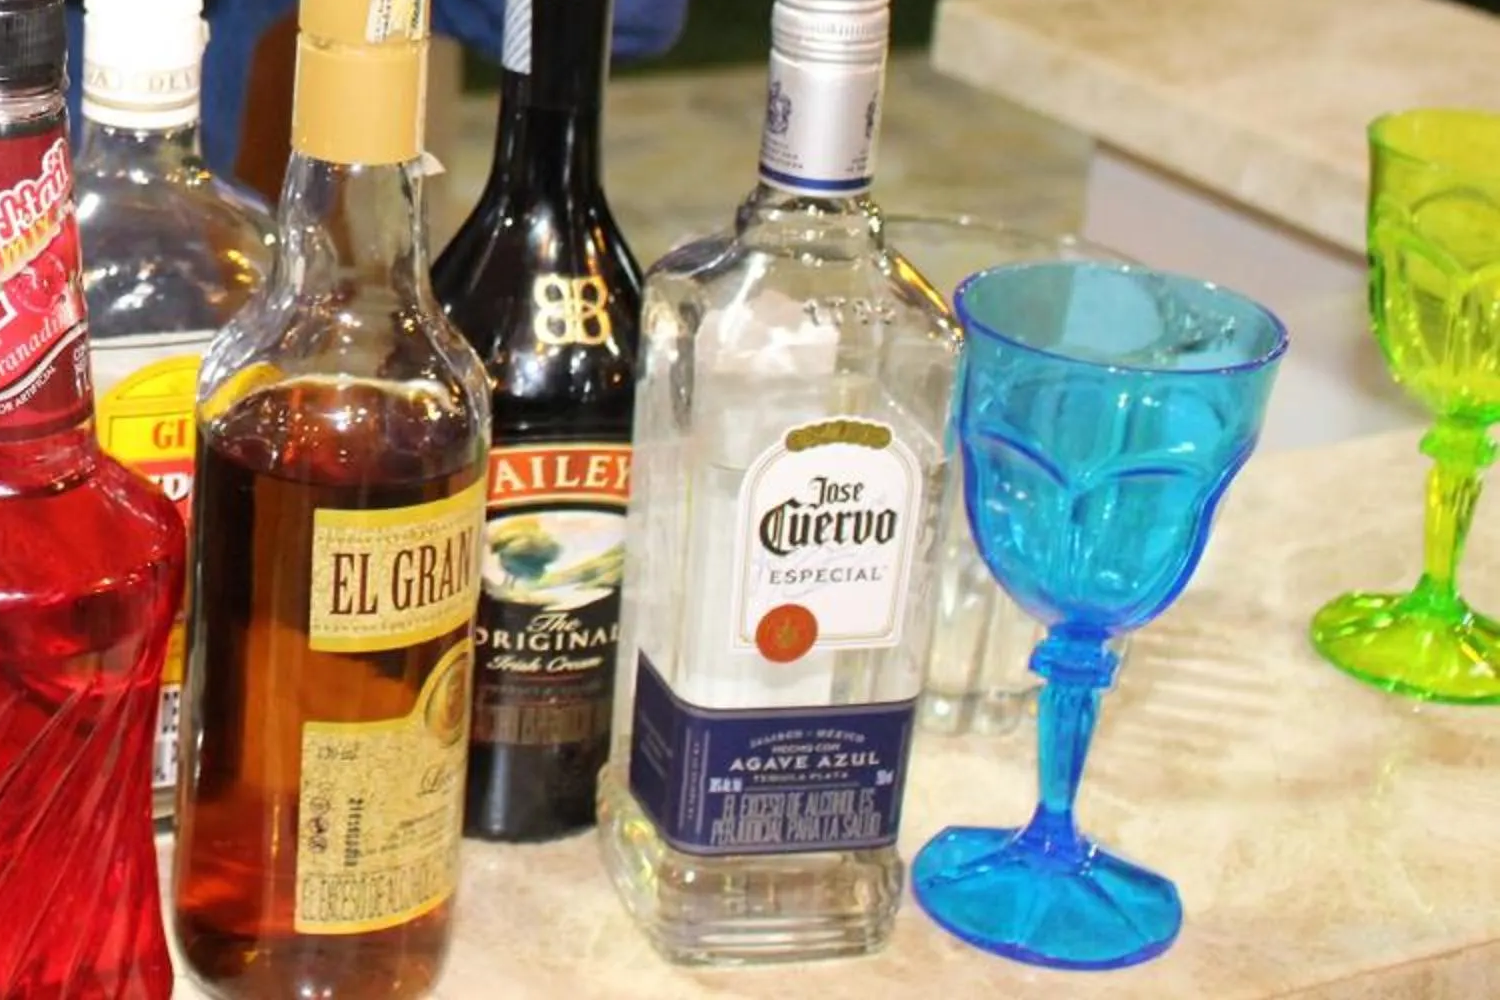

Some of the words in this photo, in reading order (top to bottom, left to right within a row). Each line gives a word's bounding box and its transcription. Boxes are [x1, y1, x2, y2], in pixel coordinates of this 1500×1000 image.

[494, 455, 631, 493] AILEY
[808, 475, 865, 509] Jose
[759, 497, 897, 557] Cuervo
[329, 552, 378, 615] EL
[391, 526, 474, 611] GRAN
[769, 567, 882, 585] ESPECIAL
[475, 622, 620, 651] ORIGINAL
[526, 612, 582, 633] The
[729, 754, 808, 772] AGAVE
[817, 751, 880, 769] AZUL
